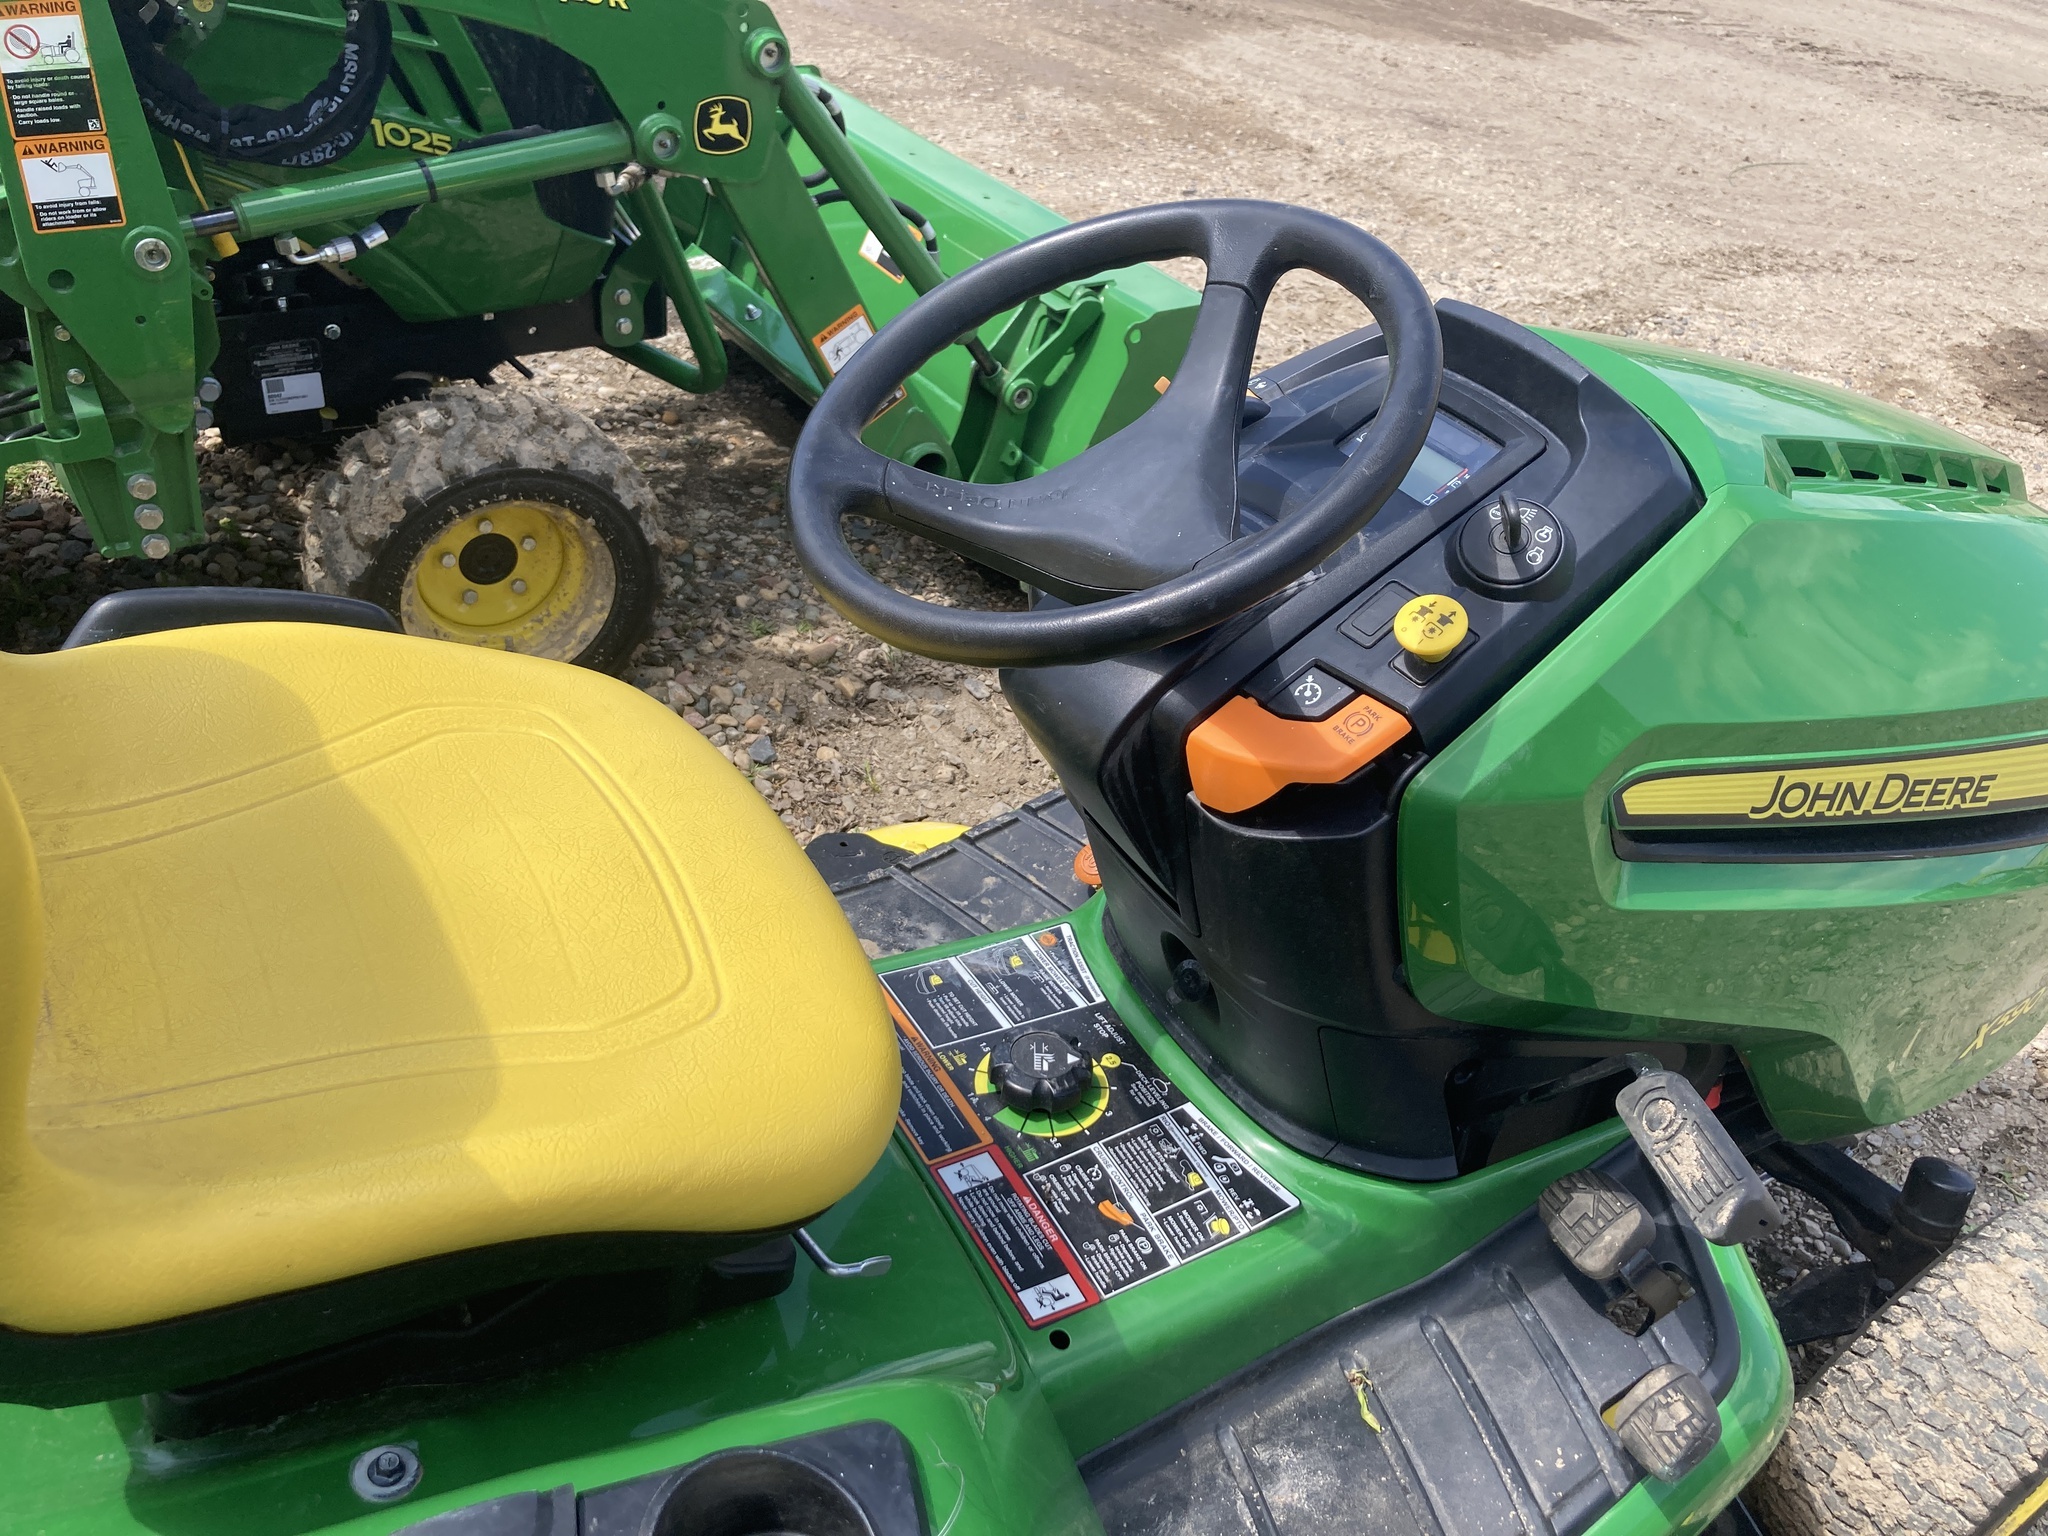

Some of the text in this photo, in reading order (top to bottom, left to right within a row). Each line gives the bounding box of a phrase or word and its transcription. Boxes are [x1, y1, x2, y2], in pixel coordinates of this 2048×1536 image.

[4, 1, 77, 16] WARNING
[34, 139, 105, 154] WARNING
[827, 311, 858, 336] WARNING
[1362, 706, 1383, 722] PARK
[1332, 725, 1355, 745] BRAKE
[1749, 774, 1998, 816] JOHN DEERE
[1065, 934, 1087, 974] TRACTION ASSIST
[1032, 949, 1073, 993] POWER MOWER LIFT
[966, 979, 990, 1004] CUT HEIGHT
[997, 978, 1024, 1007] LOWER MOWER
[951, 996, 961, 1004] SET
[957, 1004, 967, 1012] CUT
[963, 1011, 978, 1027] HEIGHT
[1091, 1022, 1109, 1038] STOP
[1093, 1012, 1126, 1045] LIFT ADJUST
[914, 1041, 941, 1072] WARNING
[935, 1051, 955, 1071] LOWER
[978, 1041, 991, 1052] 1.5
[1104, 1055, 1117, 1065] 2.5
[902, 1037, 915, 1051] AVOID
[911, 1050, 928, 1069] SERIOUS
[924, 1069, 939, 1085] INJURY
[935, 1084, 945, 1093] OR
[940, 1091, 955, 1108] DEATH
[1129, 1082, 1152, 1107] See manual
[1134, 1069, 1170, 1110] DECK LEVELING
[1134, 1080, 1157, 1105] POSITION
[982, 1114, 992, 1122] 4
[1159, 1115, 1171, 1127] RIO
[1003, 1145, 1024, 1169] HIGHER
[1048, 1136, 1062, 1149] 3.5
[1135, 1135, 1165, 1172] while reversing:
[1140, 1133, 1181, 1183] To keep PTO engaged
[1193, 1141, 1208, 1155] FWD
[1196, 1116, 1220, 1135] BRAKE
[1219, 1137, 1251, 1164] FORWARD
[1250, 1166, 1281, 1192] REVERSE
[1073, 1163, 1095, 1190] CRUISE ON
[1092, 1145, 1135, 1201] CRUISE CONTROL
[1123, 1158, 1136, 1173] before
[1132, 1172, 1150, 1193] reversing
[1125, 1141, 1164, 1192] before and while backing
[1130, 1139, 1167, 1185] Look down and behind
[981, 1187, 1001, 1213] are around
[1047, 1173, 1064, 1192] CRUISE
[1060, 1191, 1070, 1202] OFF
[1060, 1176, 1082, 1202] Push button
[1227, 1187, 1241, 1201] REV
[963, 1194, 987, 1227] while backing
[1006, 1197, 1045, 1251] OFF ARMS AND LEGS
[1010, 1192, 1053, 1251] ROTATING BLADES CUT
[1026, 1201, 1059, 1243] DANGER
[1213, 1189, 1246, 1230] MOWER/PTO
[968, 1191, 1024, 1271] Look down and behind before and
[1138, 1212, 1175, 1260] PARK BRAKE
[1162, 1220, 1187, 1254] Lower handle
[1165, 1215, 1192, 1249] MOWER OFF
[1177, 1215, 1200, 1245] Raise handle
[1180, 1209, 1206, 1242] MOWER ON
[1092, 1238, 1125, 1282] PARK BRAKE OFF
[1095, 1252, 1111, 1273] Depress
[1107, 1247, 1131, 1278] Raise handle
[1112, 1245, 1134, 1273] brake pedal
[1117, 1228, 1149, 1271] PARK BRAKE ON
[1117, 1243, 1135, 1263] Depress
[1084, 1256, 1108, 1289] Lower handle
